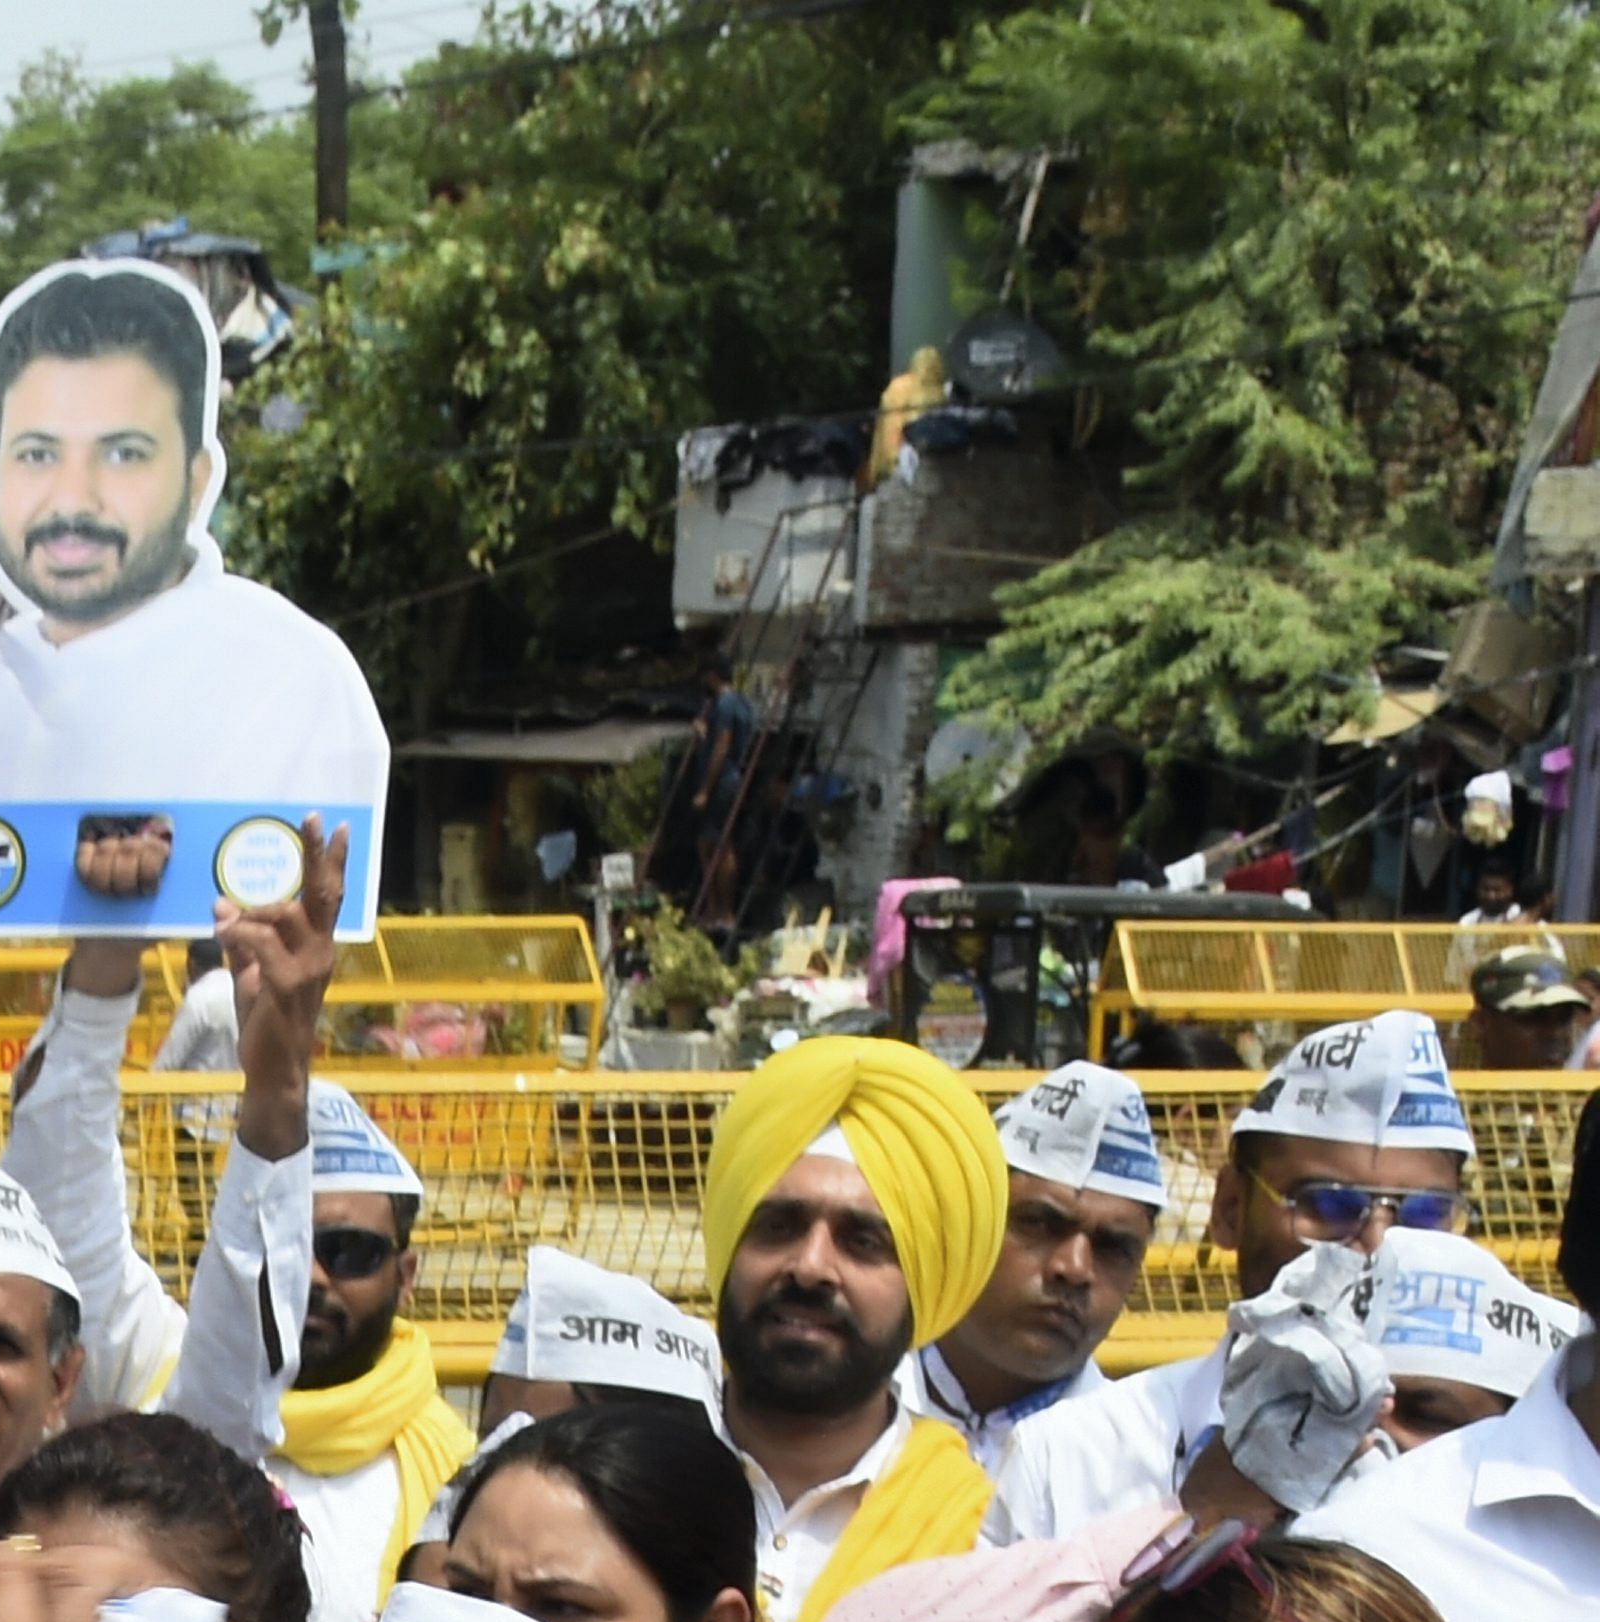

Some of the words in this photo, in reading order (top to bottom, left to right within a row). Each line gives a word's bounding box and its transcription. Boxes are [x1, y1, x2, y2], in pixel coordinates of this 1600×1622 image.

[1299, 1021, 1375, 1071] पार्टी
[1029, 1078, 1087, 1122] पार्टी
[1388, 1270, 1487, 1337] आप
[558, 1314, 643, 1350] आम
